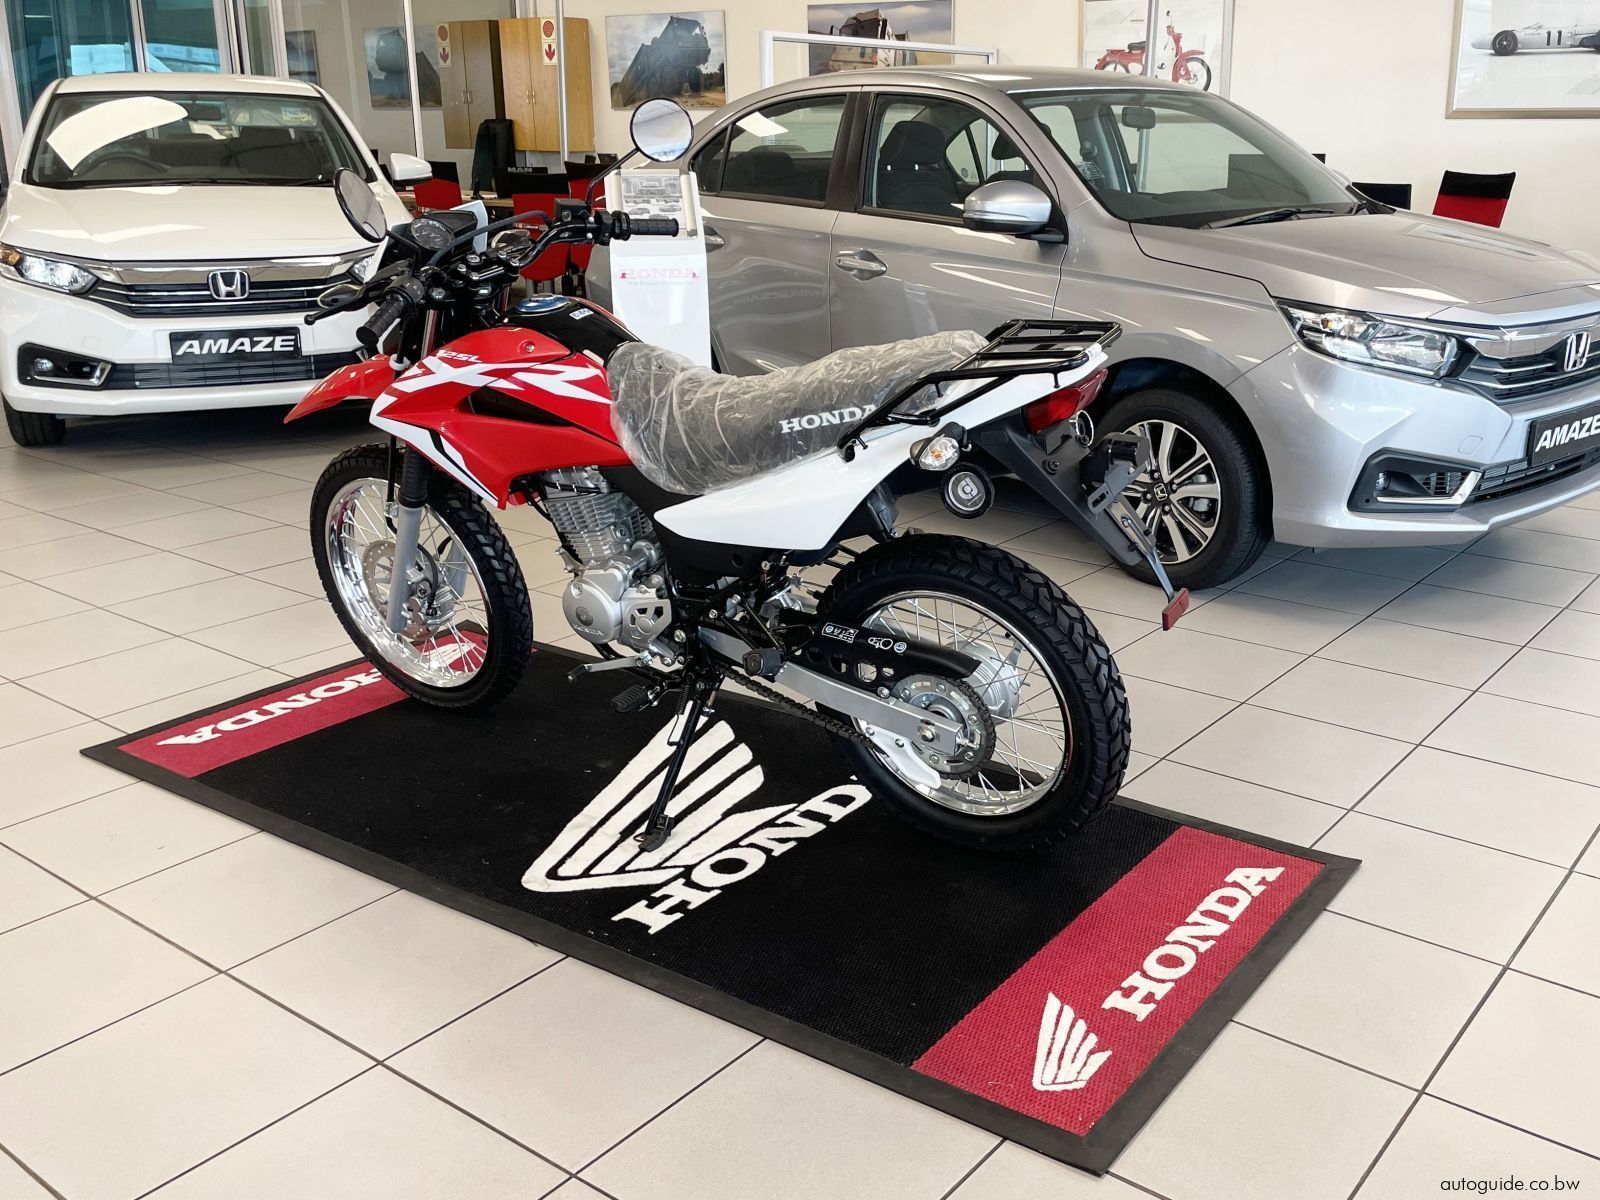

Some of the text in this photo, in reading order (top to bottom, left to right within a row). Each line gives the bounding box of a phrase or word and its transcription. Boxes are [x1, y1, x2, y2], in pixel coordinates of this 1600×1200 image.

[1546, 30, 1562, 46] 11
[175, 335, 297, 356] AMAZE
[1534, 413, 1600, 453] AMAZE
[611, 774, 873, 935] HOND
[1101, 866, 1286, 1023] HONDA
